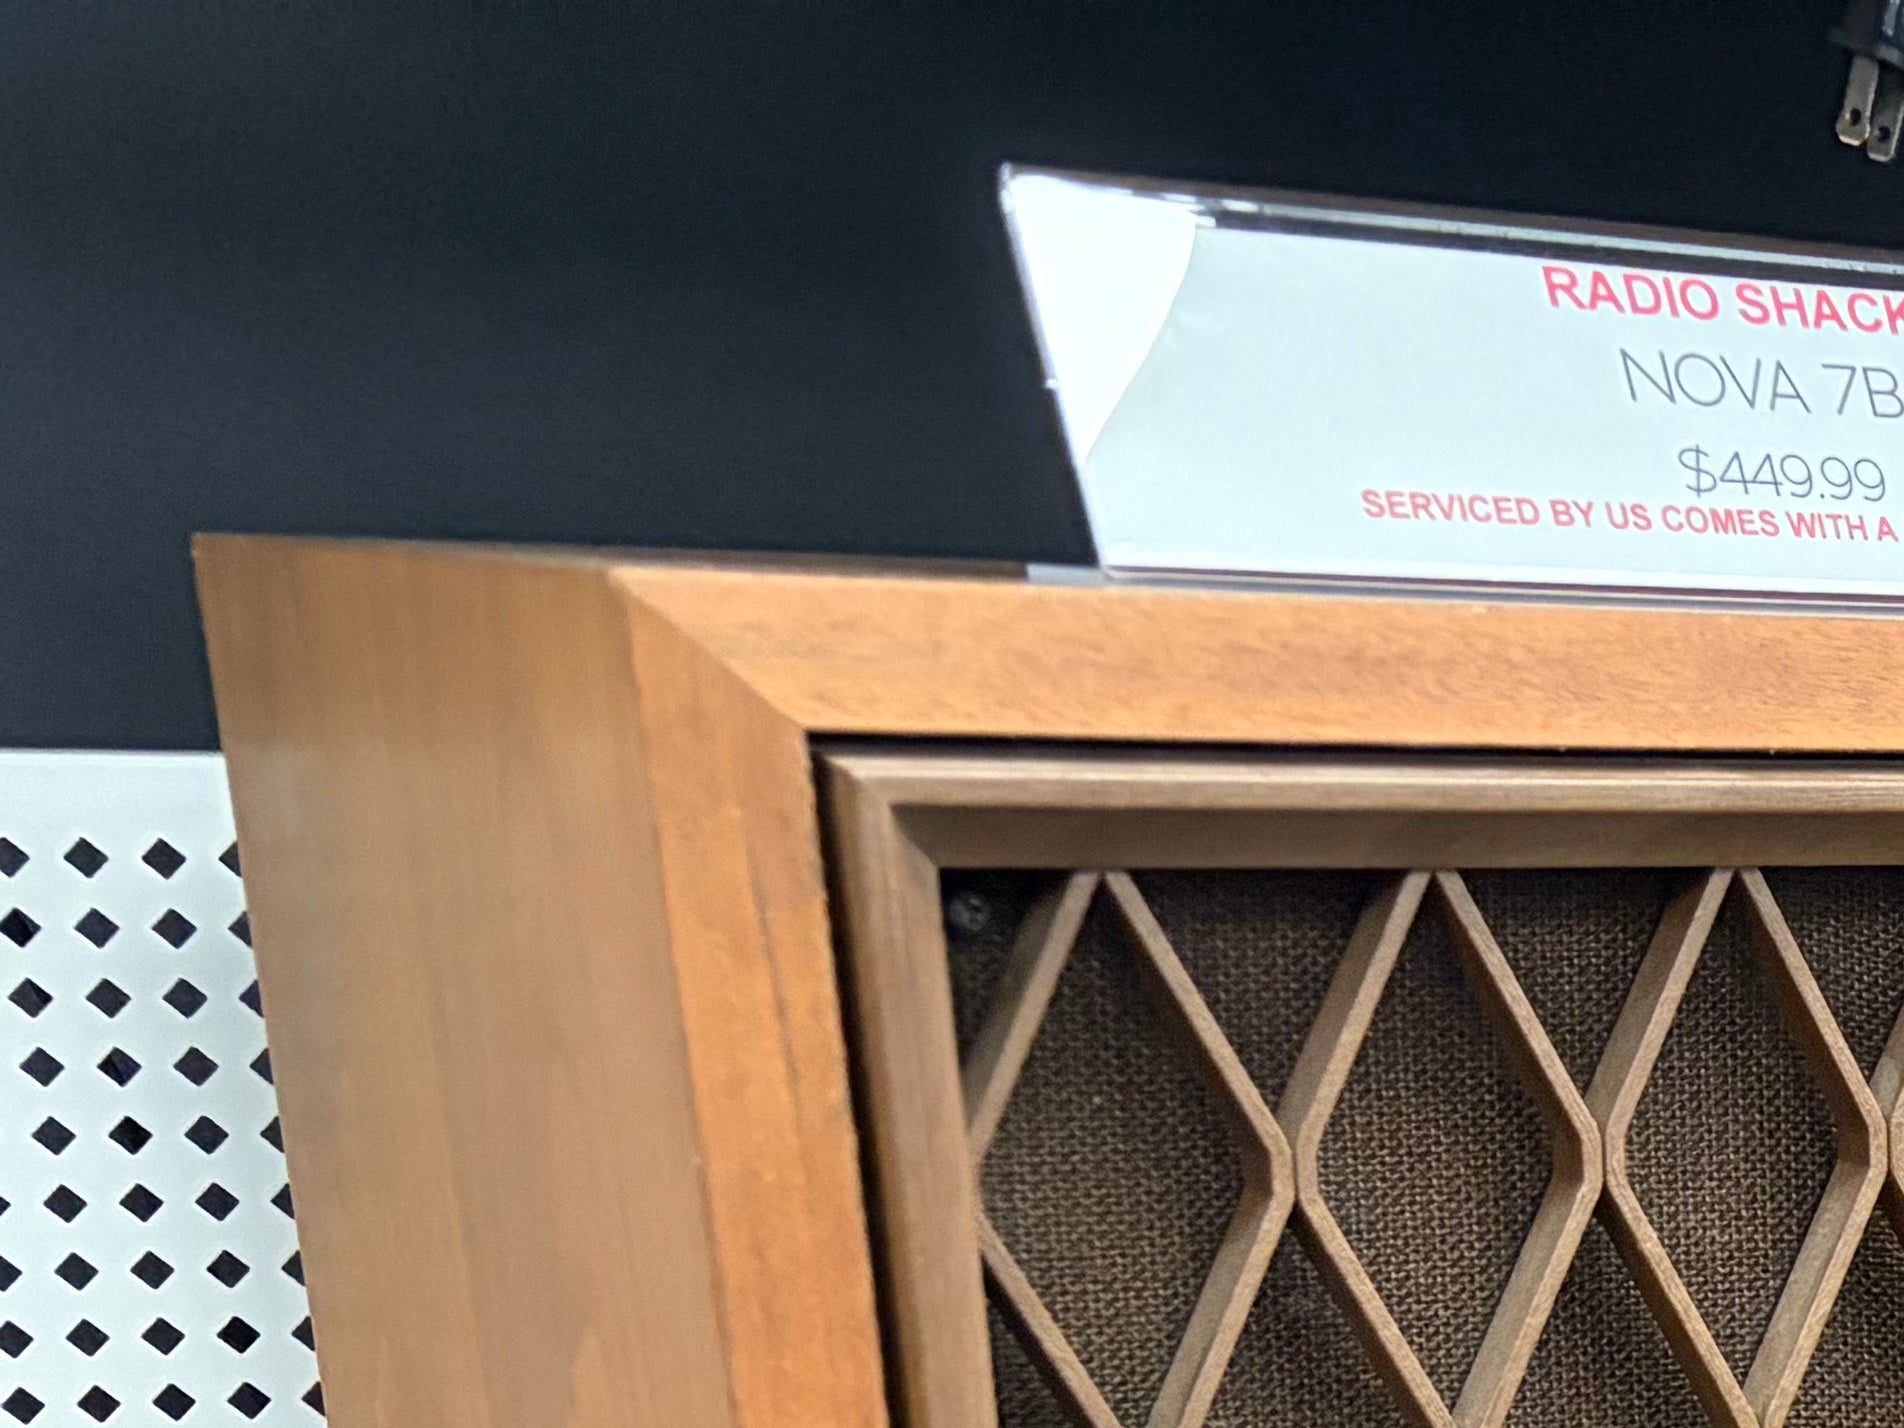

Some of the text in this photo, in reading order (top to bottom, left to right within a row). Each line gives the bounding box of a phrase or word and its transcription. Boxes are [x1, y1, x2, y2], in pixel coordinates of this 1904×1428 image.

[1541, 265, 1719, 321] RADIO
[1619, 346, 1904, 419] NOVA 7B
[1677, 444, 1886, 502] $449.99
[1361, 489, 1540, 526] SERVICED
[1549, 499, 1594, 528] BY
[1605, 502, 1653, 532] US
[1660, 504, 1780, 538] COMES
[1785, 511, 1868, 541] WITH
[1876, 516, 1899, 543] A
